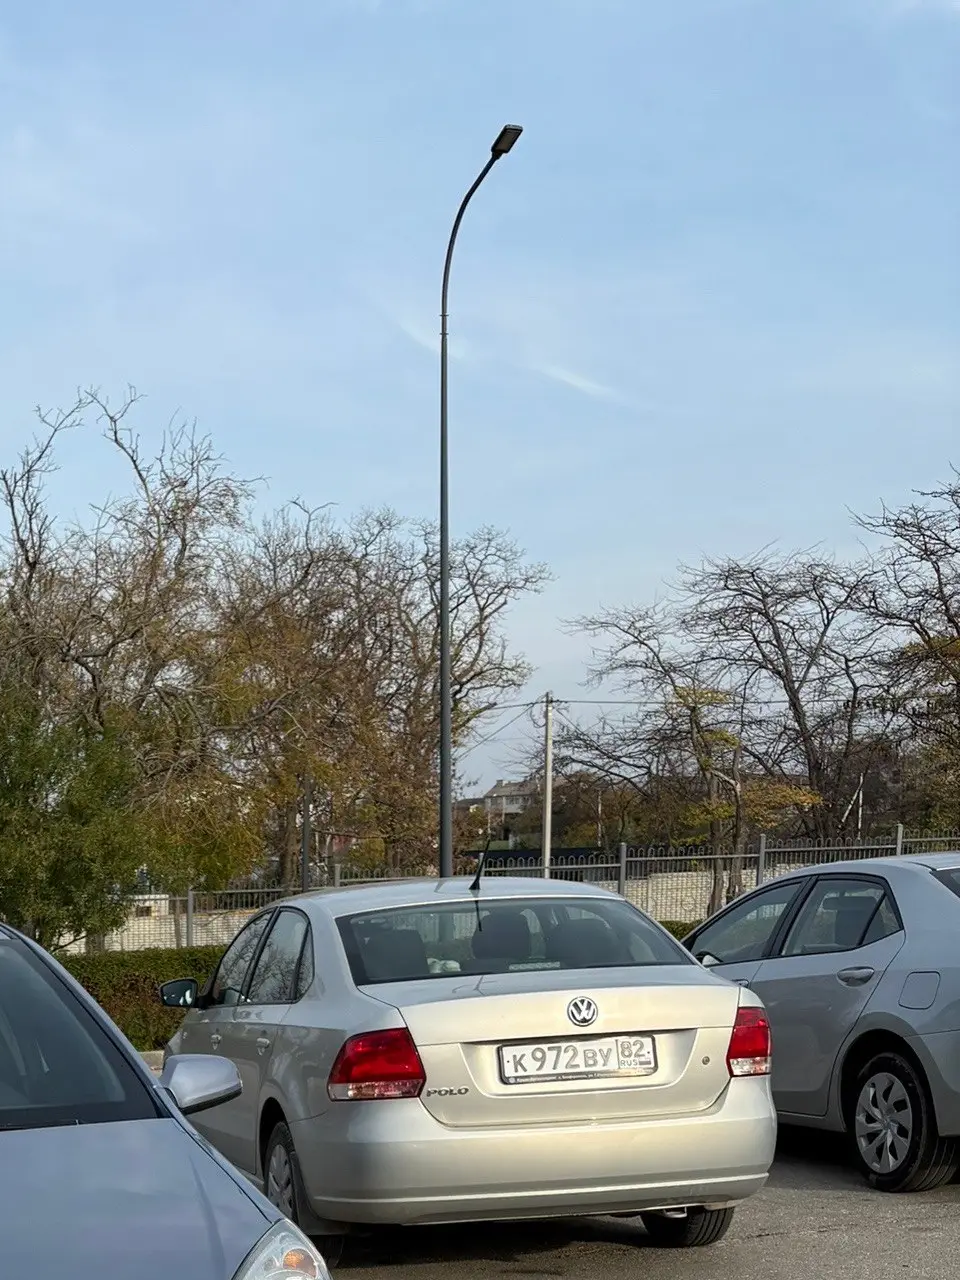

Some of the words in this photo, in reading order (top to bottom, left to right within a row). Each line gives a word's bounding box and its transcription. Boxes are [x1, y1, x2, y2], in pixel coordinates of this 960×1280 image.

[620, 1039, 646, 1059] 82
[620, 1058, 639, 1067] RUS
[426, 1087, 469, 1097] POLO
